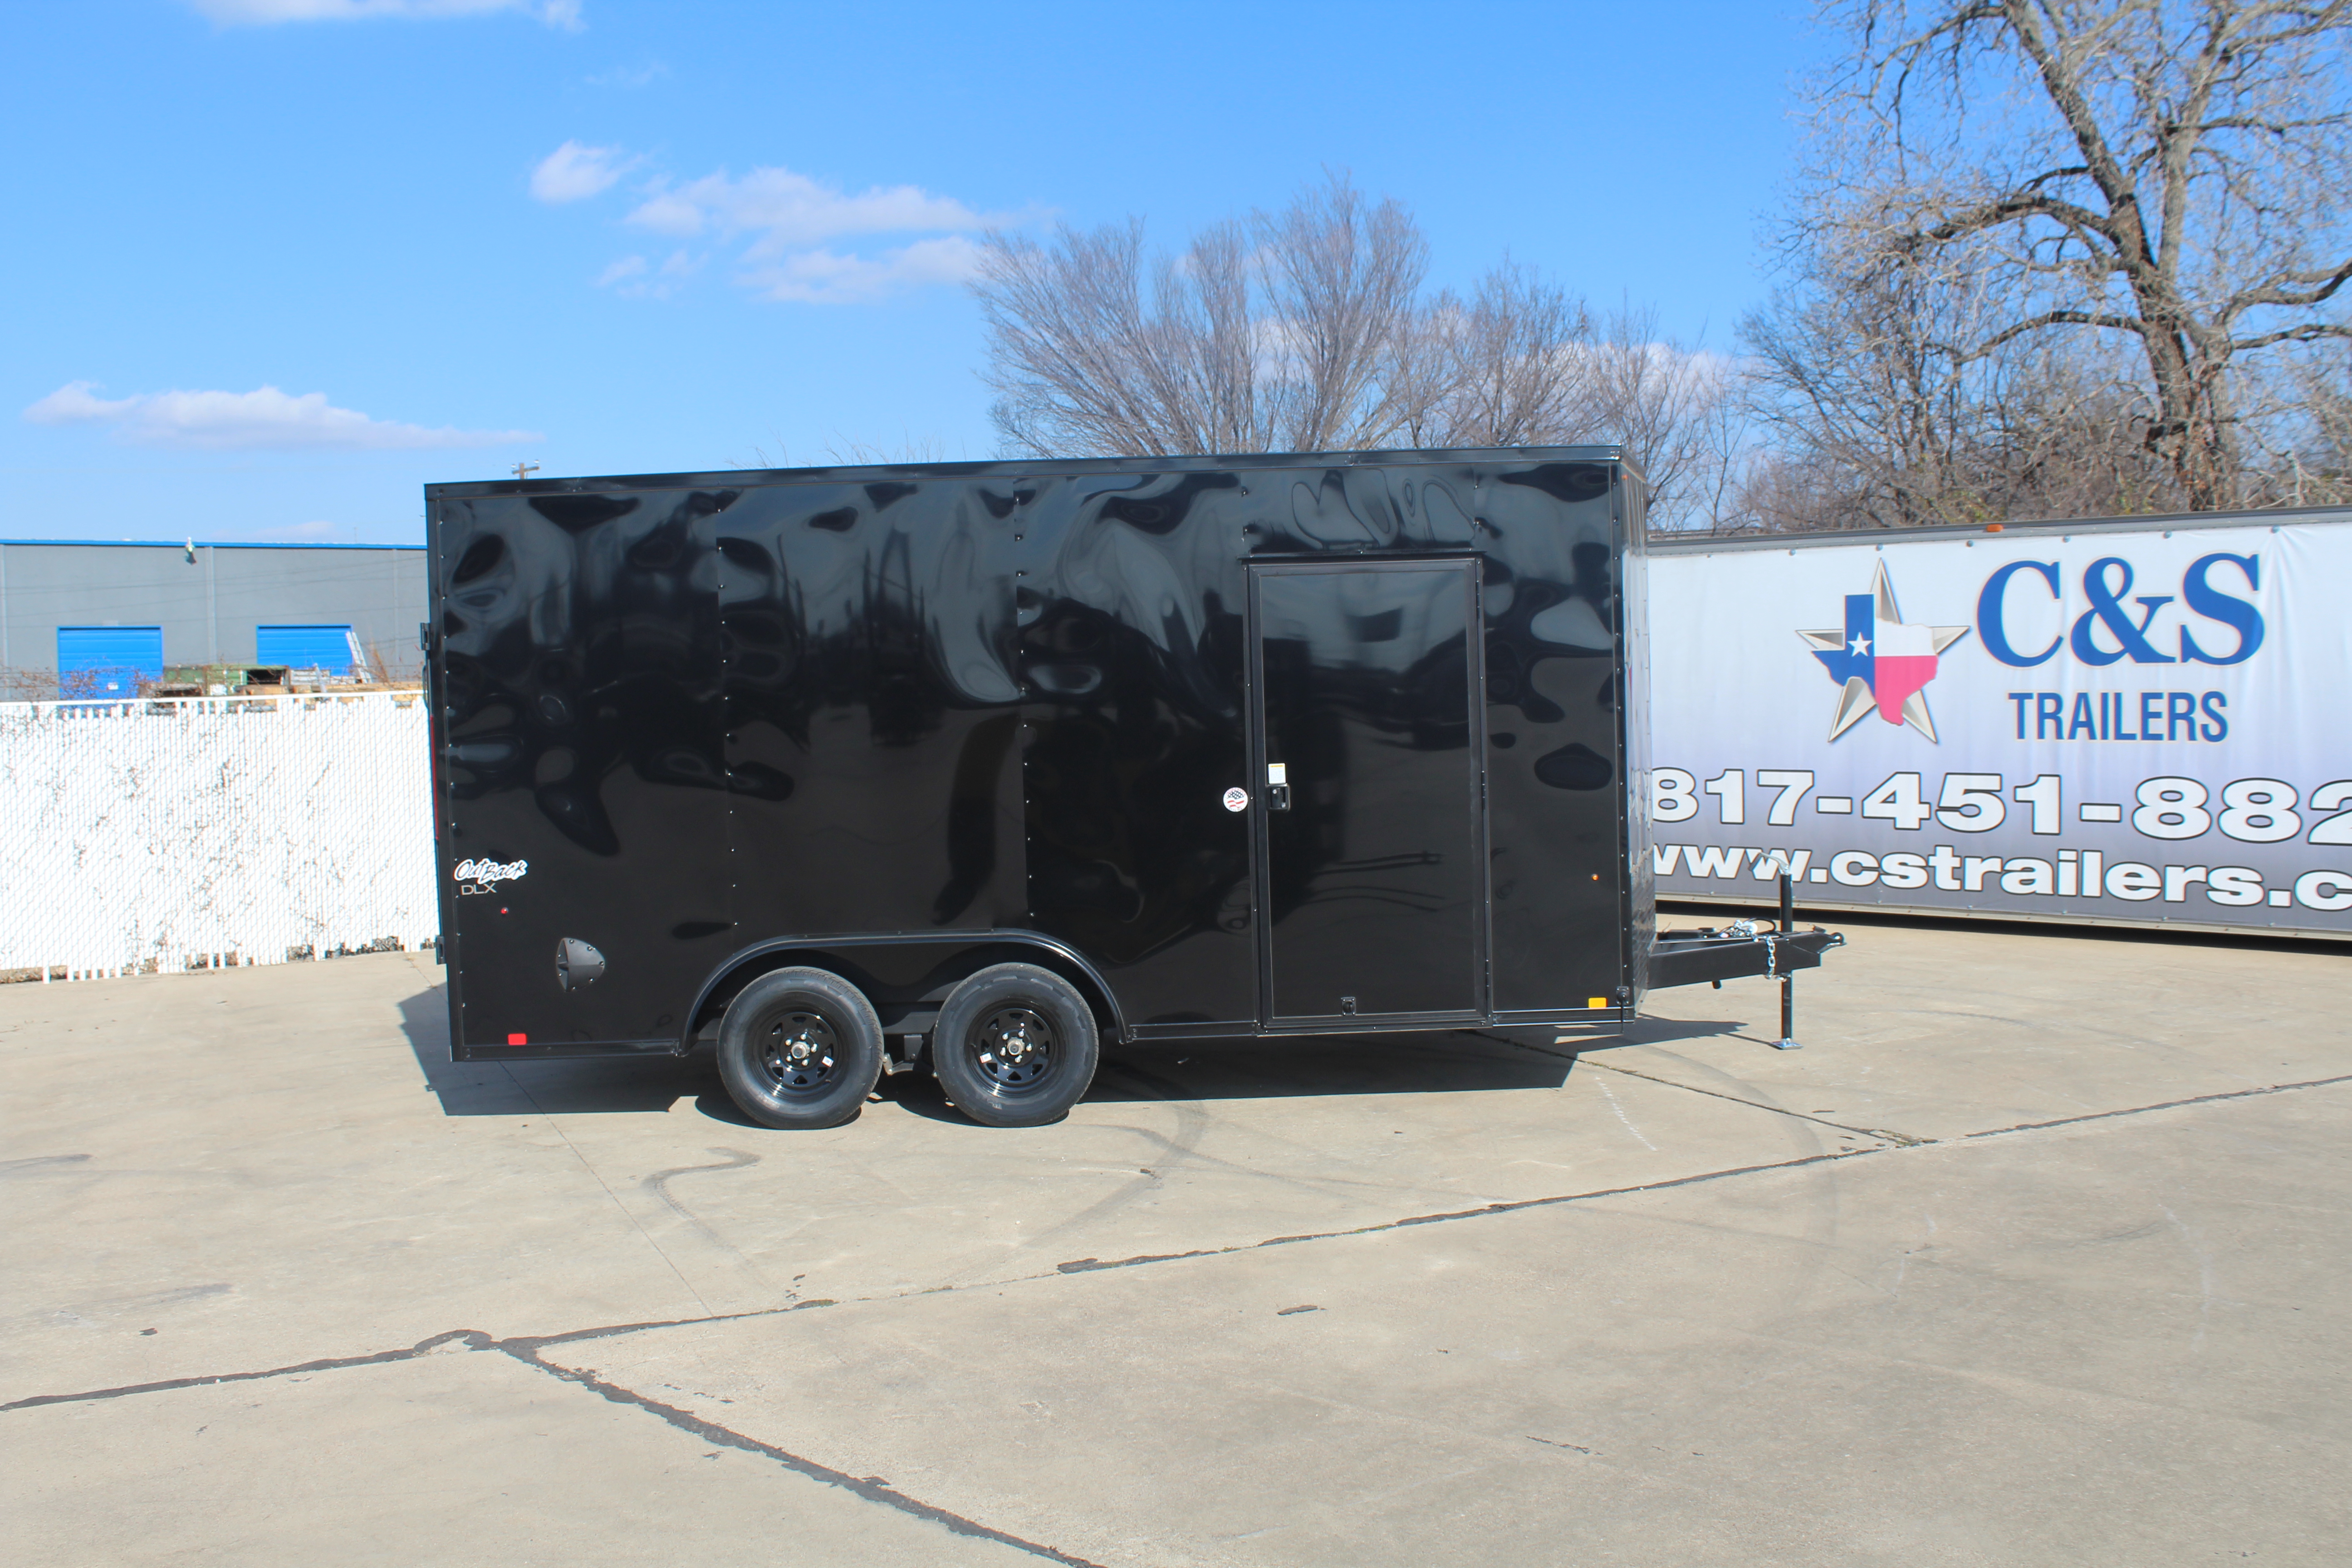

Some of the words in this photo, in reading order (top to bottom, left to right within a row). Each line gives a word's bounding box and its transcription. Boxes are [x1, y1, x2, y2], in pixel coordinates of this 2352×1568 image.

[1977, 553, 2265, 667] C&S
[2008, 691, 2228, 742] TRAILERS
[461, 882, 497, 895] DLX
